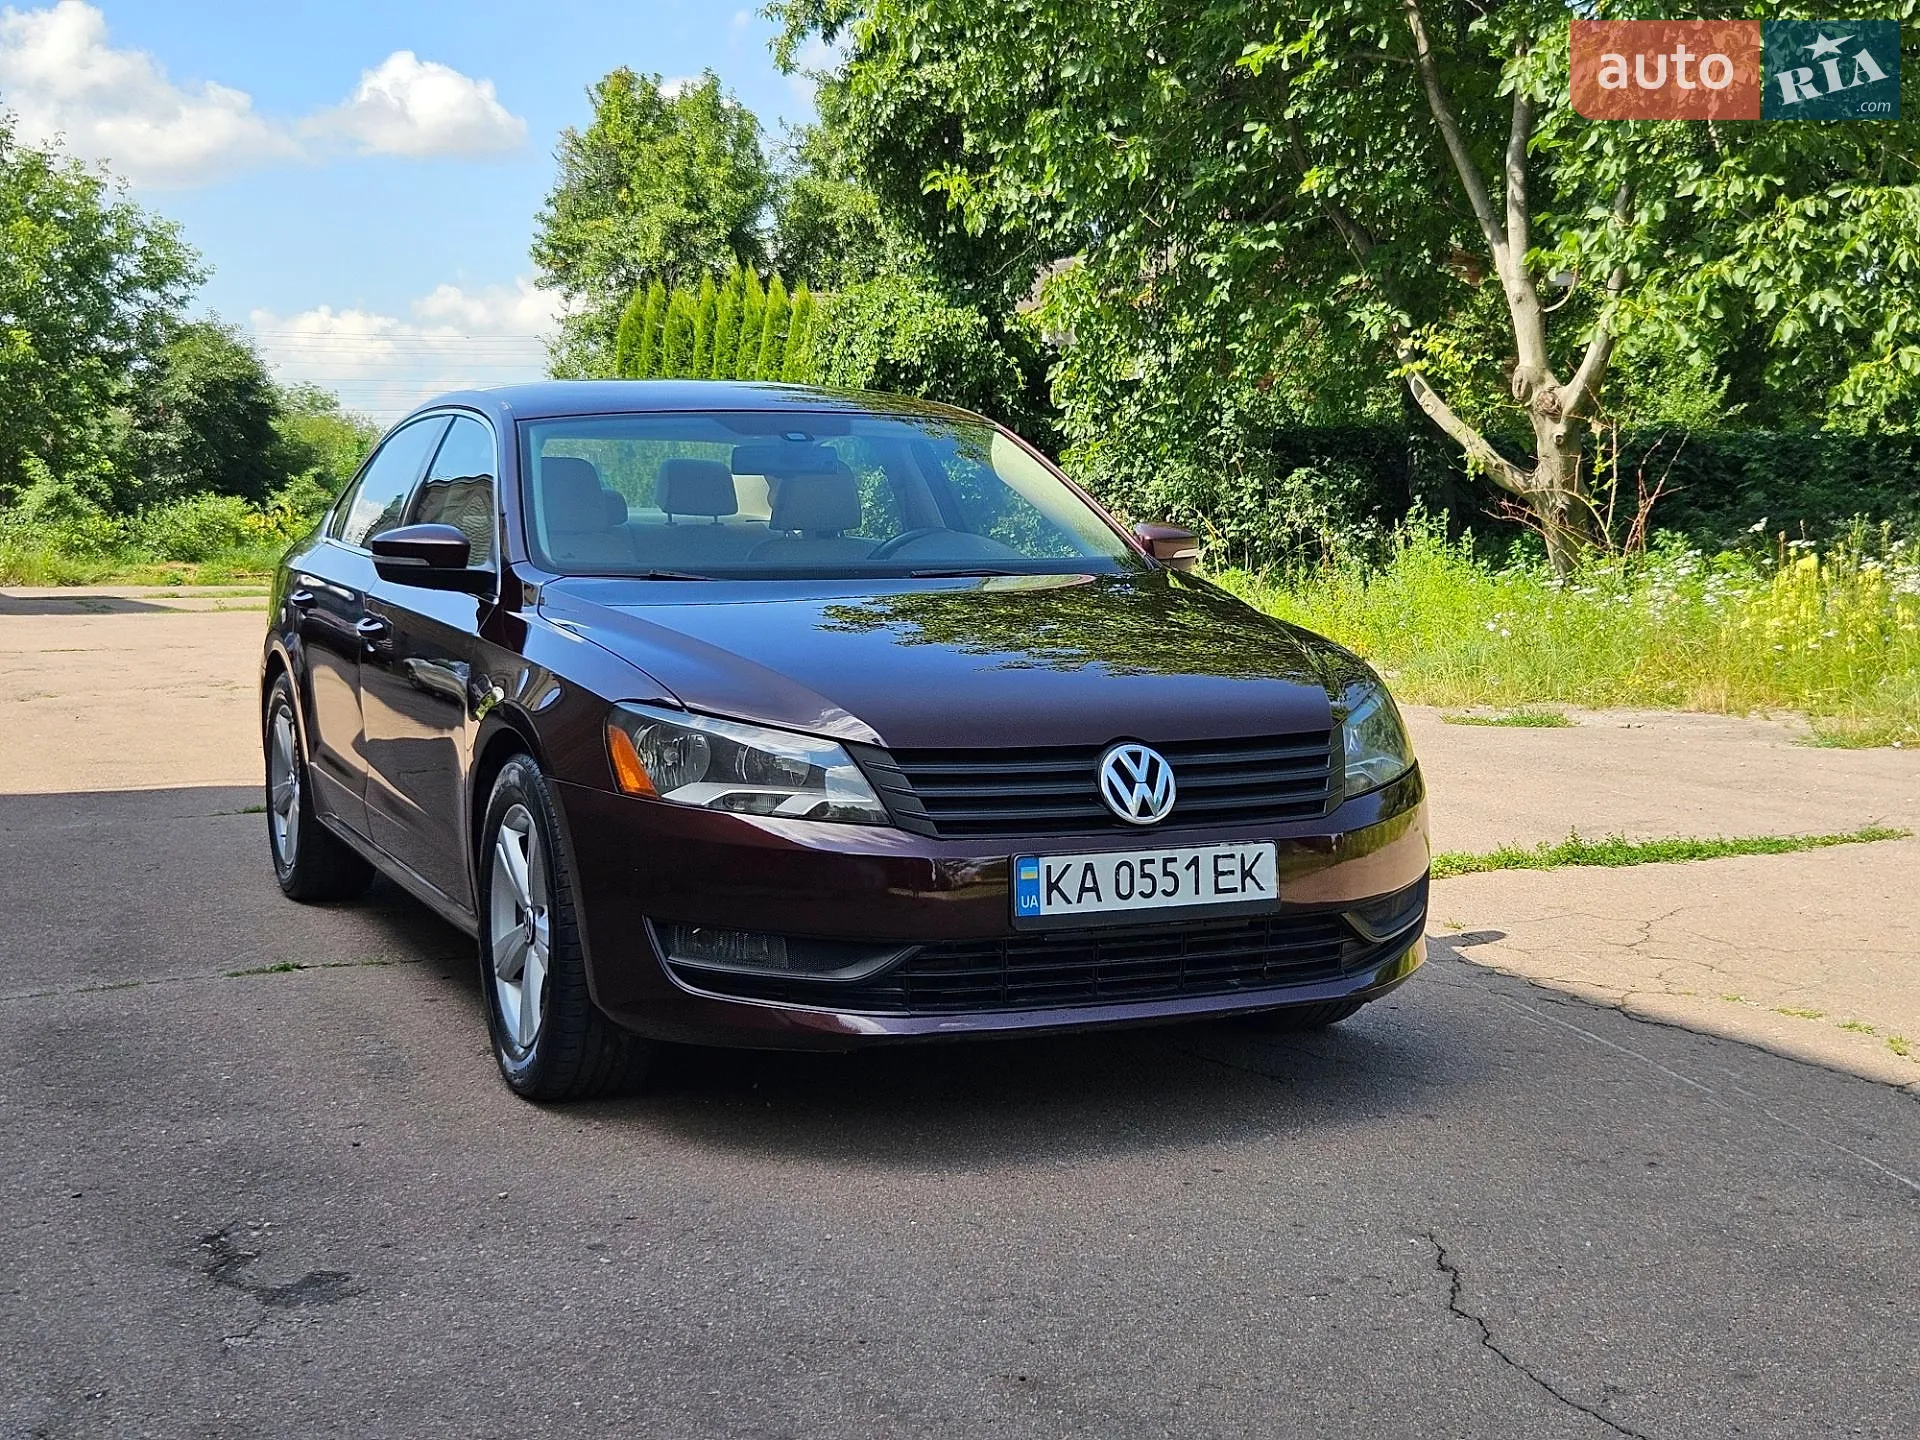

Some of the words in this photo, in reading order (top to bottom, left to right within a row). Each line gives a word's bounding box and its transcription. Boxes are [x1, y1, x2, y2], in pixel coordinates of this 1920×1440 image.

[1045, 861, 1103, 906] KA
[1114, 855, 1201, 901] 0551
[1213, 851, 1266, 895] EK
[1020, 895, 1039, 909] UA
